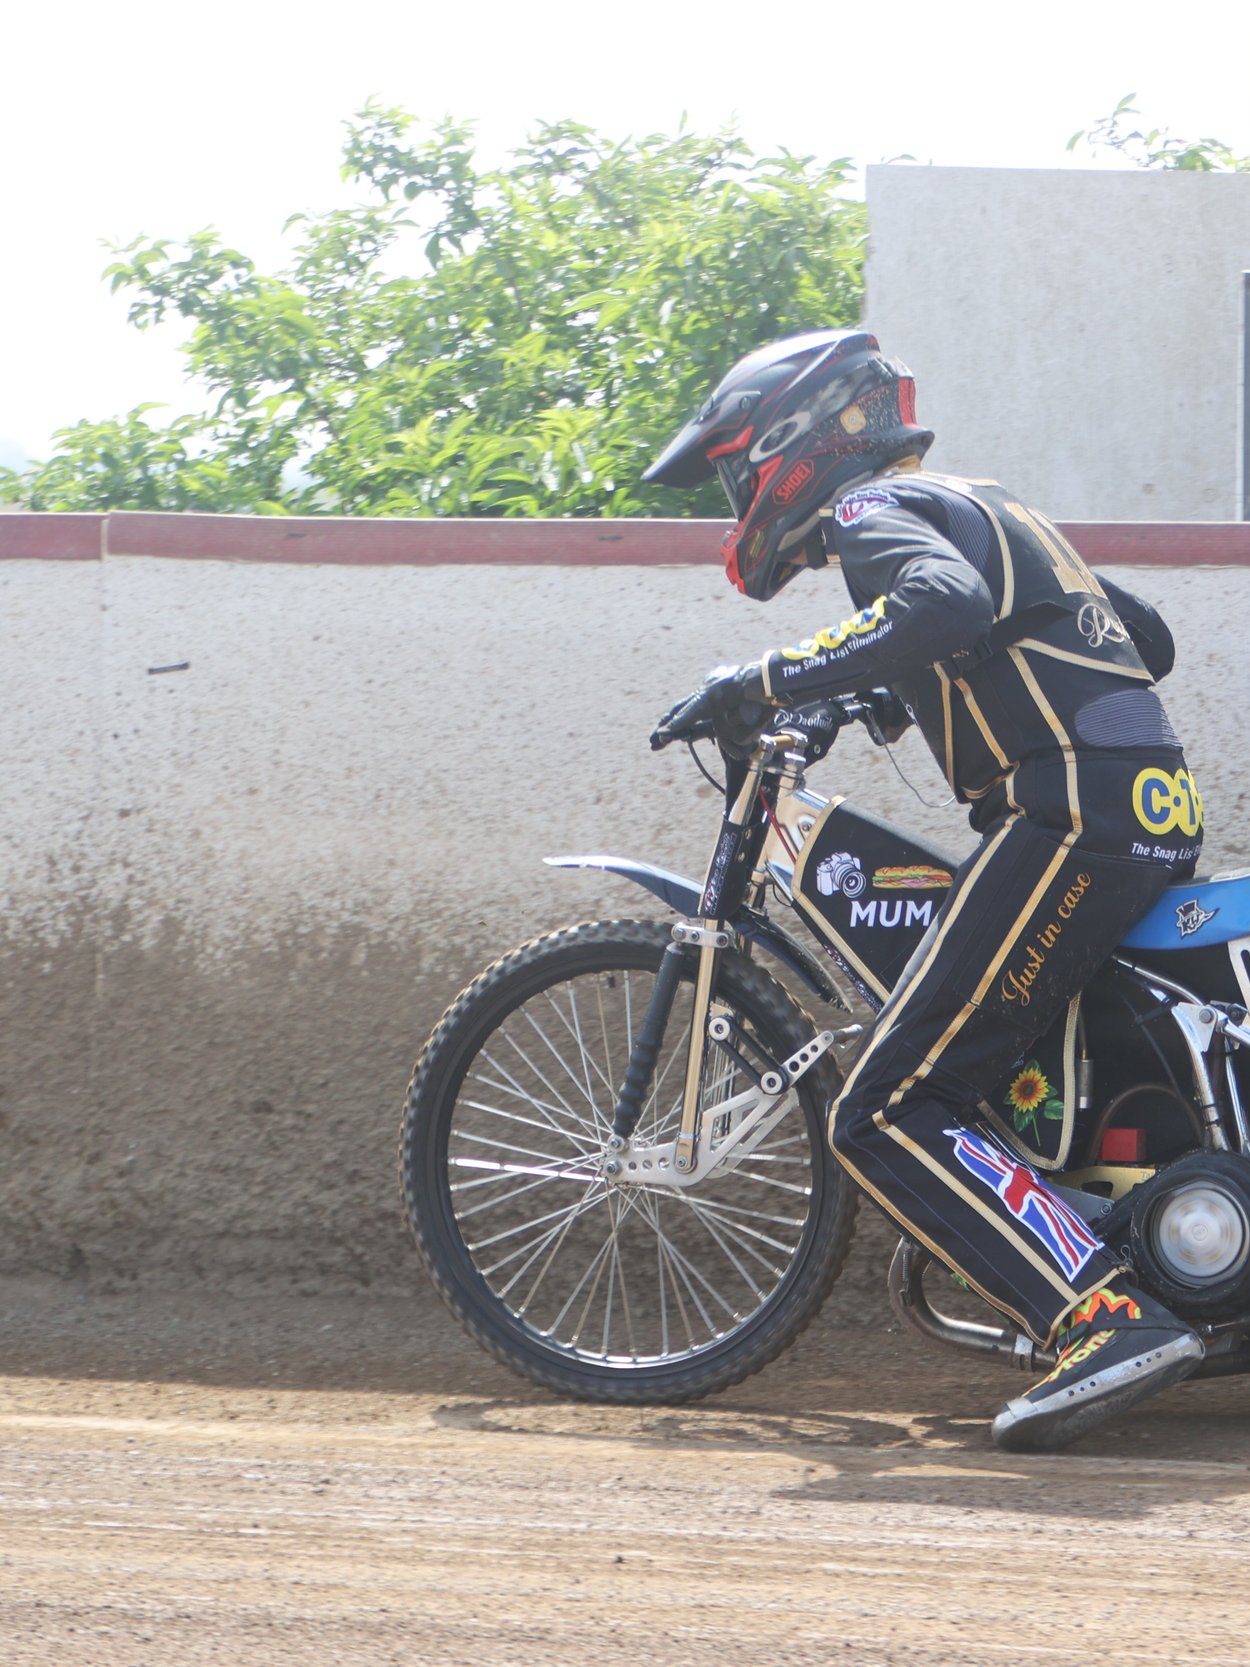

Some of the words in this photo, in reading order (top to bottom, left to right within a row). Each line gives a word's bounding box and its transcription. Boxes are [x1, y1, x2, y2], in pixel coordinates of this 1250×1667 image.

[776, 463, 811, 500] SHOEI
[782, 663, 801, 678] The
[803, 654, 827, 671] Snag
[830, 646, 849, 660] List
[847, 620, 893, 653] Eliminator
[1131, 842, 1150, 856] The
[1153, 845, 1177, 862] Snag
[1178, 848, 1194, 860] Lis
[850, 901, 932, 927] MUM
[1002, 943, 1045, 1007] Just
[1038, 923, 1062, 948] in
[1057, 872, 1090, 919] case
